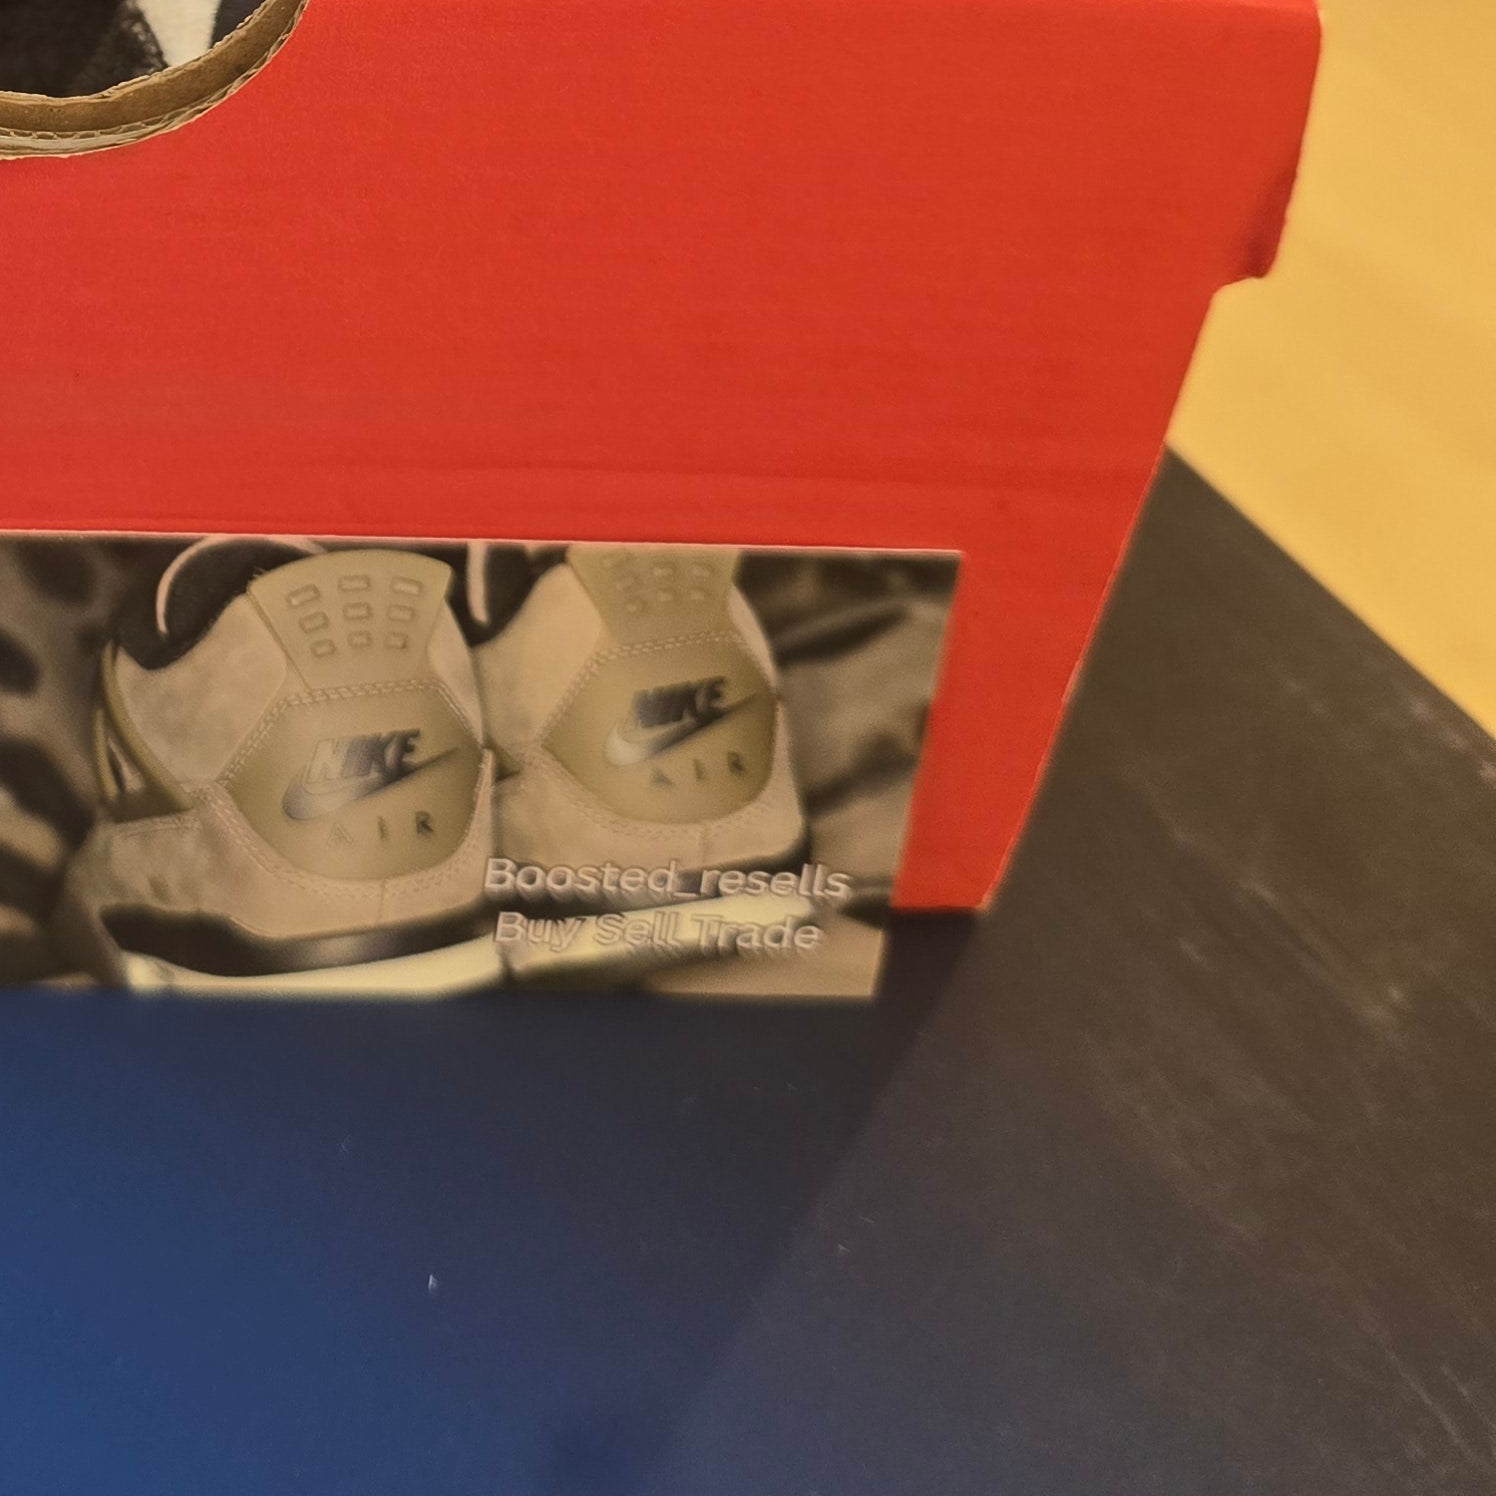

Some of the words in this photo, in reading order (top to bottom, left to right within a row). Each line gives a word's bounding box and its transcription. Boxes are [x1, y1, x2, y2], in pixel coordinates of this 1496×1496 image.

[630, 675, 731, 728] NIKE
[306, 728, 421, 785] NIKE
[650, 750, 747, 786] AIR
[329, 810, 434, 845] AIR
[484, 857, 854, 898] Boosted_resells
[494, 912, 587, 952] Buy
[593, 912, 681, 946] Sell
[691, 914, 825, 950] Trade
